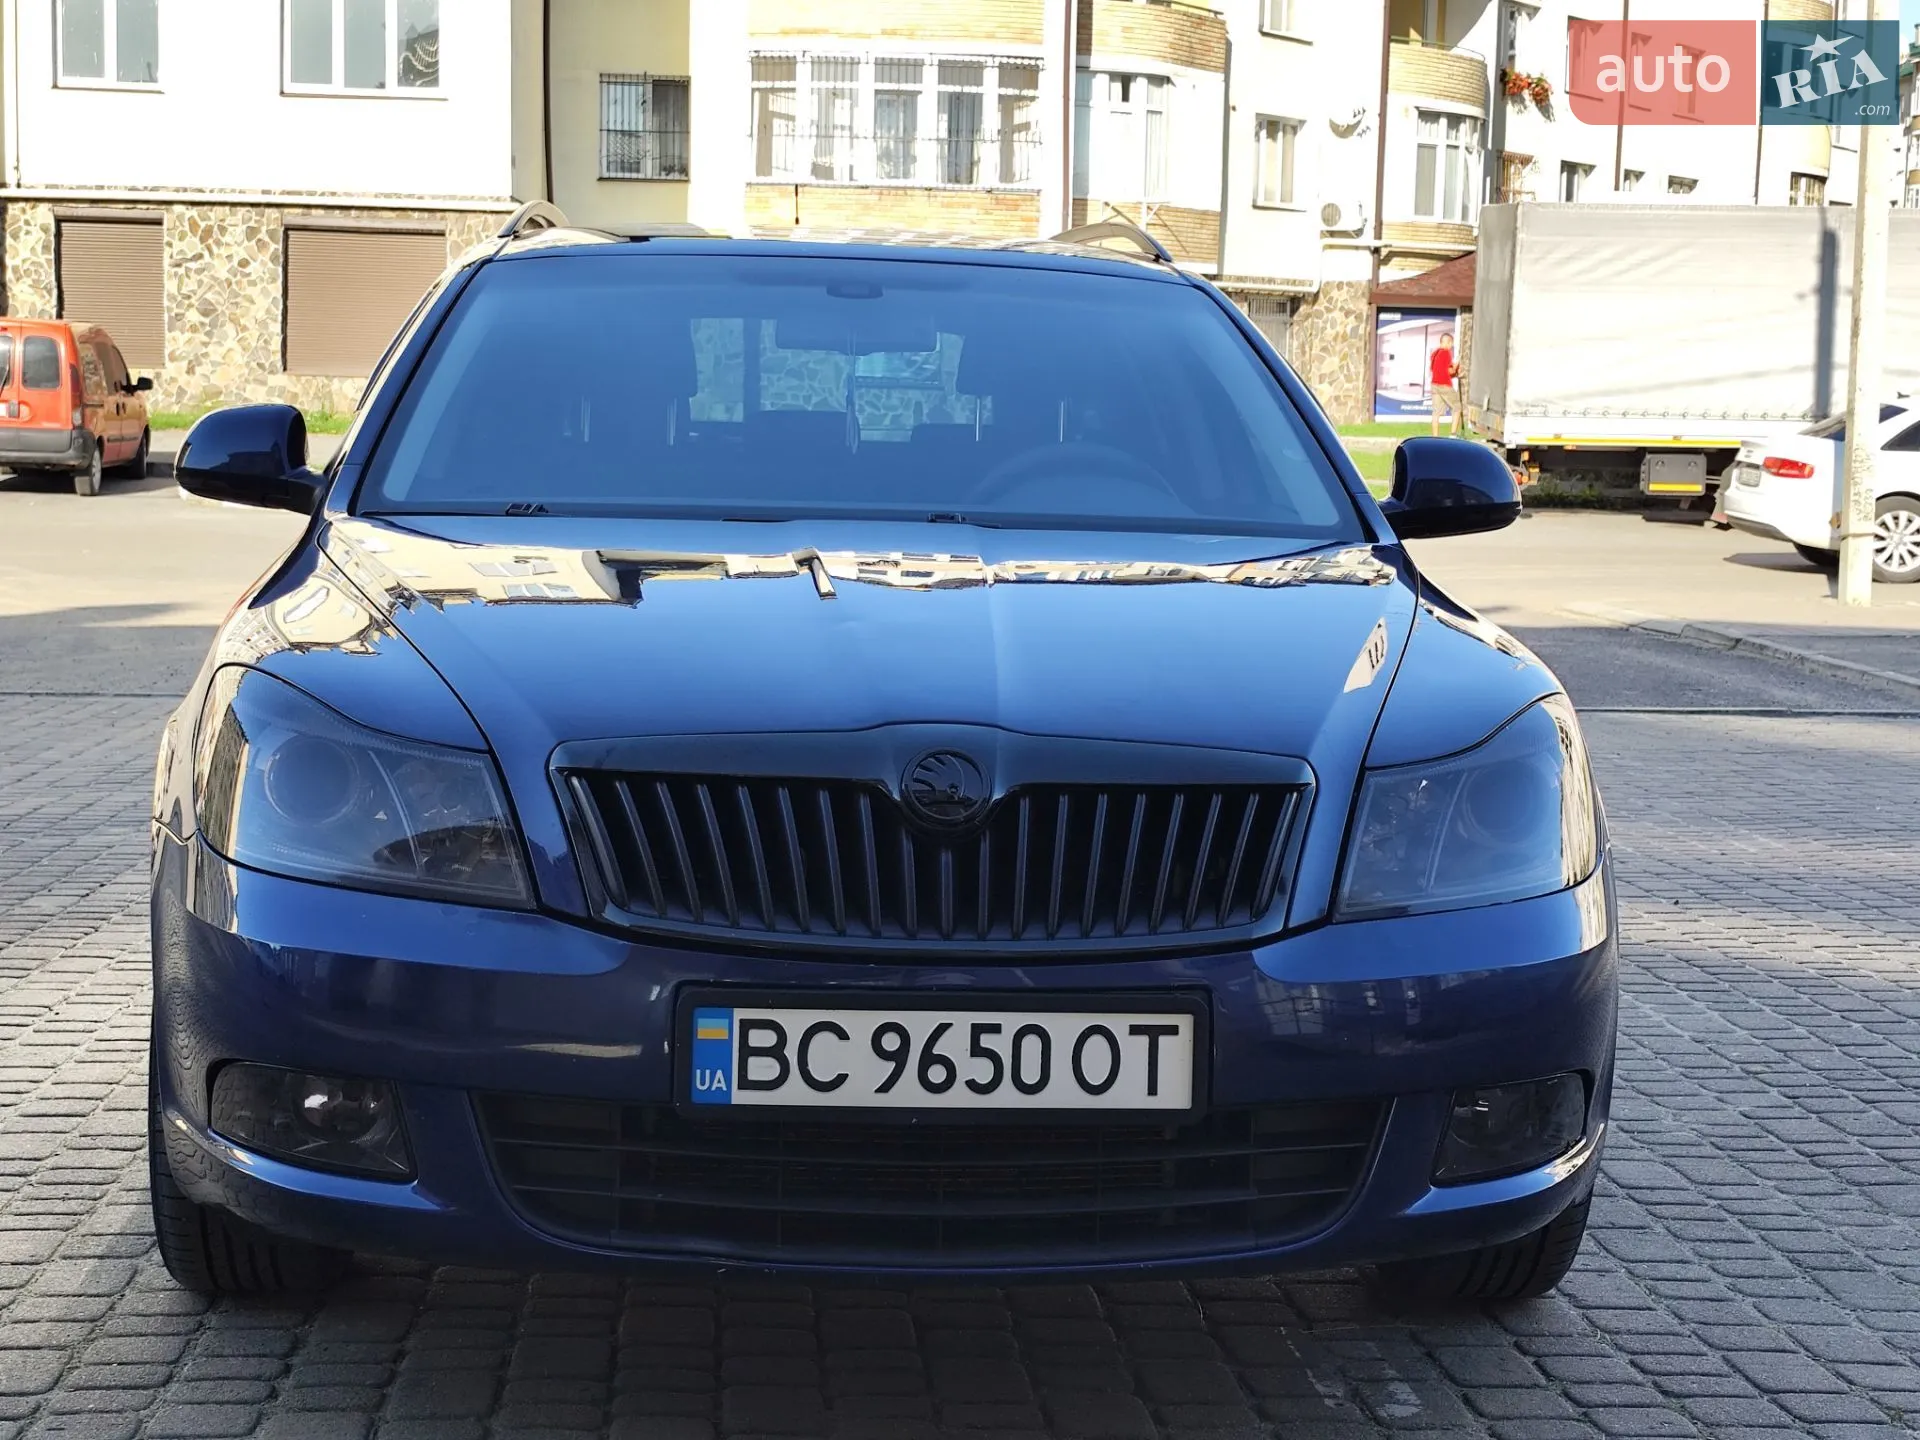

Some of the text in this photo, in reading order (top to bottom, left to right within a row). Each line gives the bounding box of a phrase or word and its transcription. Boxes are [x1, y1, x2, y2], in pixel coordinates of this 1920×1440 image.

[695, 1069, 727, 1091] UA
[737, 1018, 1180, 1096] BC 9650 OT
